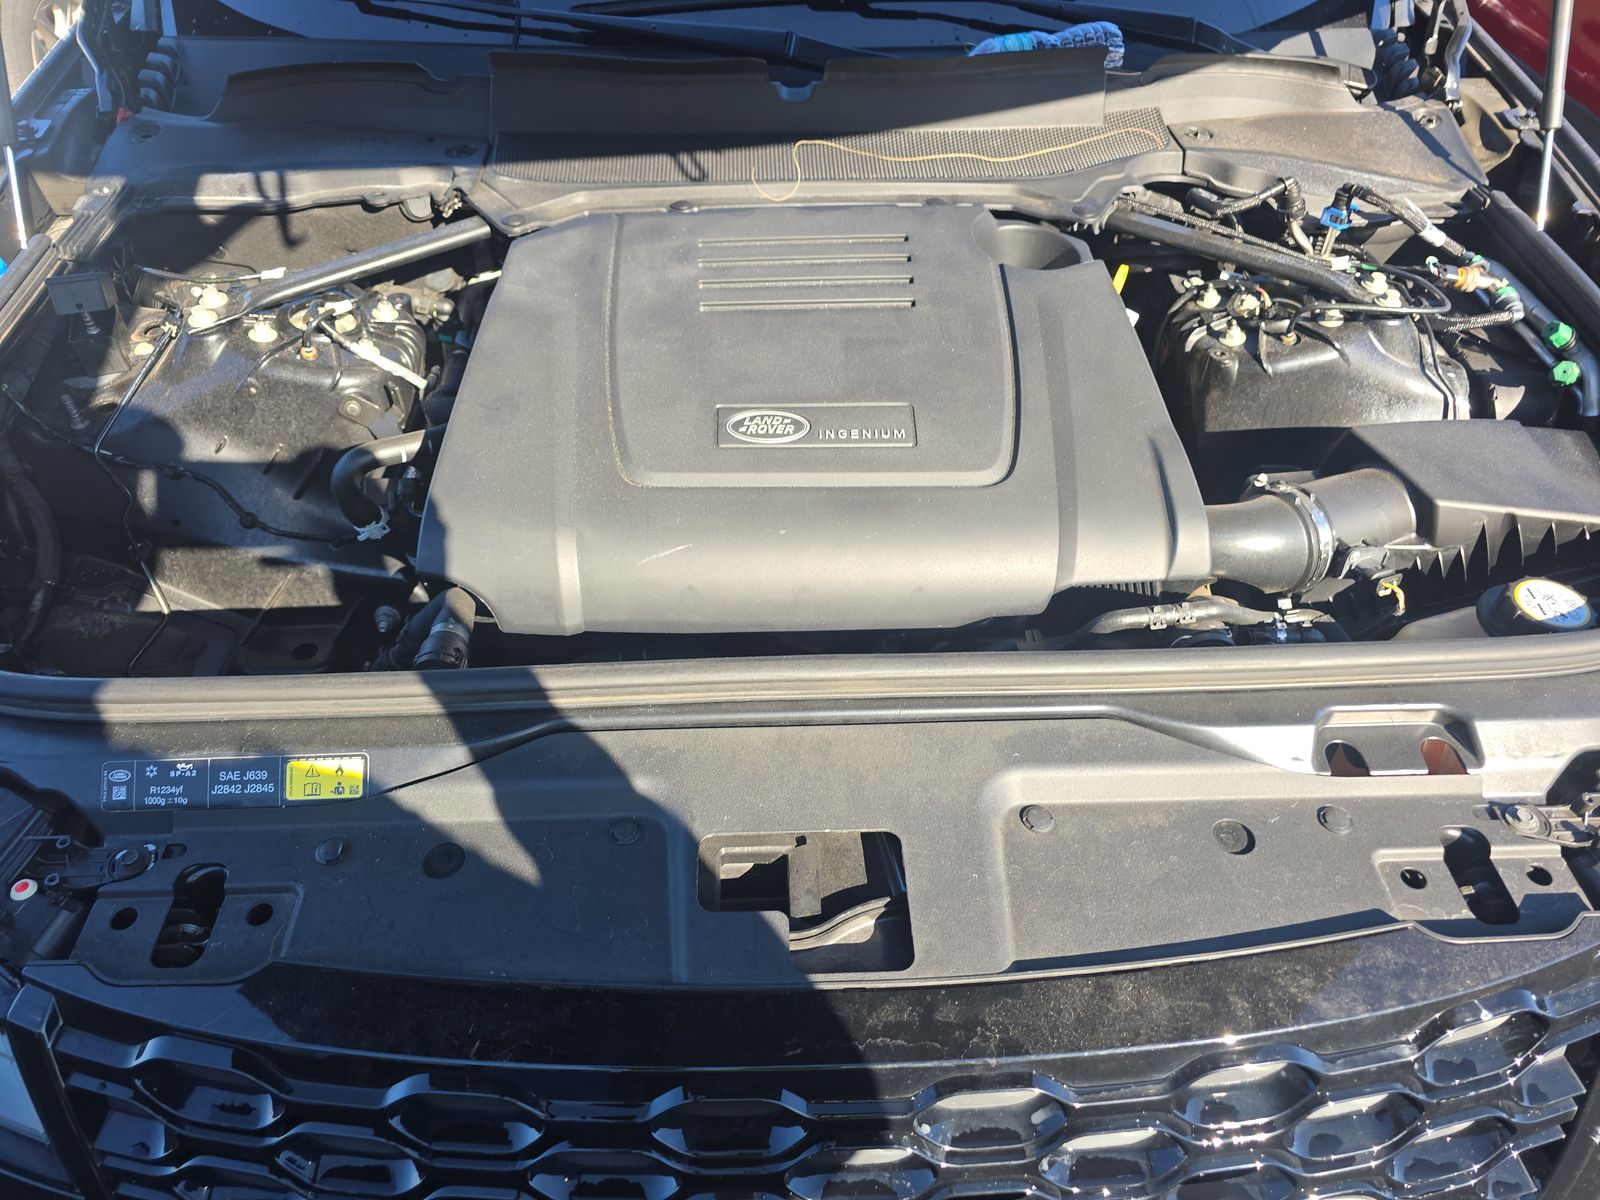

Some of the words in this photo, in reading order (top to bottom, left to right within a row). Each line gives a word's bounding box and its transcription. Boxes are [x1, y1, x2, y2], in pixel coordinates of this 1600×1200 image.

[743, 416, 784, 426] LAND
[746, 424, 795, 435] ROVER
[817, 428, 906, 440] INGENIUM
[169, 770, 197, 778] SP-A2
[219, 770, 241, 781] SAE
[243, 770, 268, 781] J639
[150, 785, 184, 796] R1234yf
[211, 784, 242, 795] J2842
[244, 783, 275, 794] J2845
[144, 796, 166, 806] 1000g
